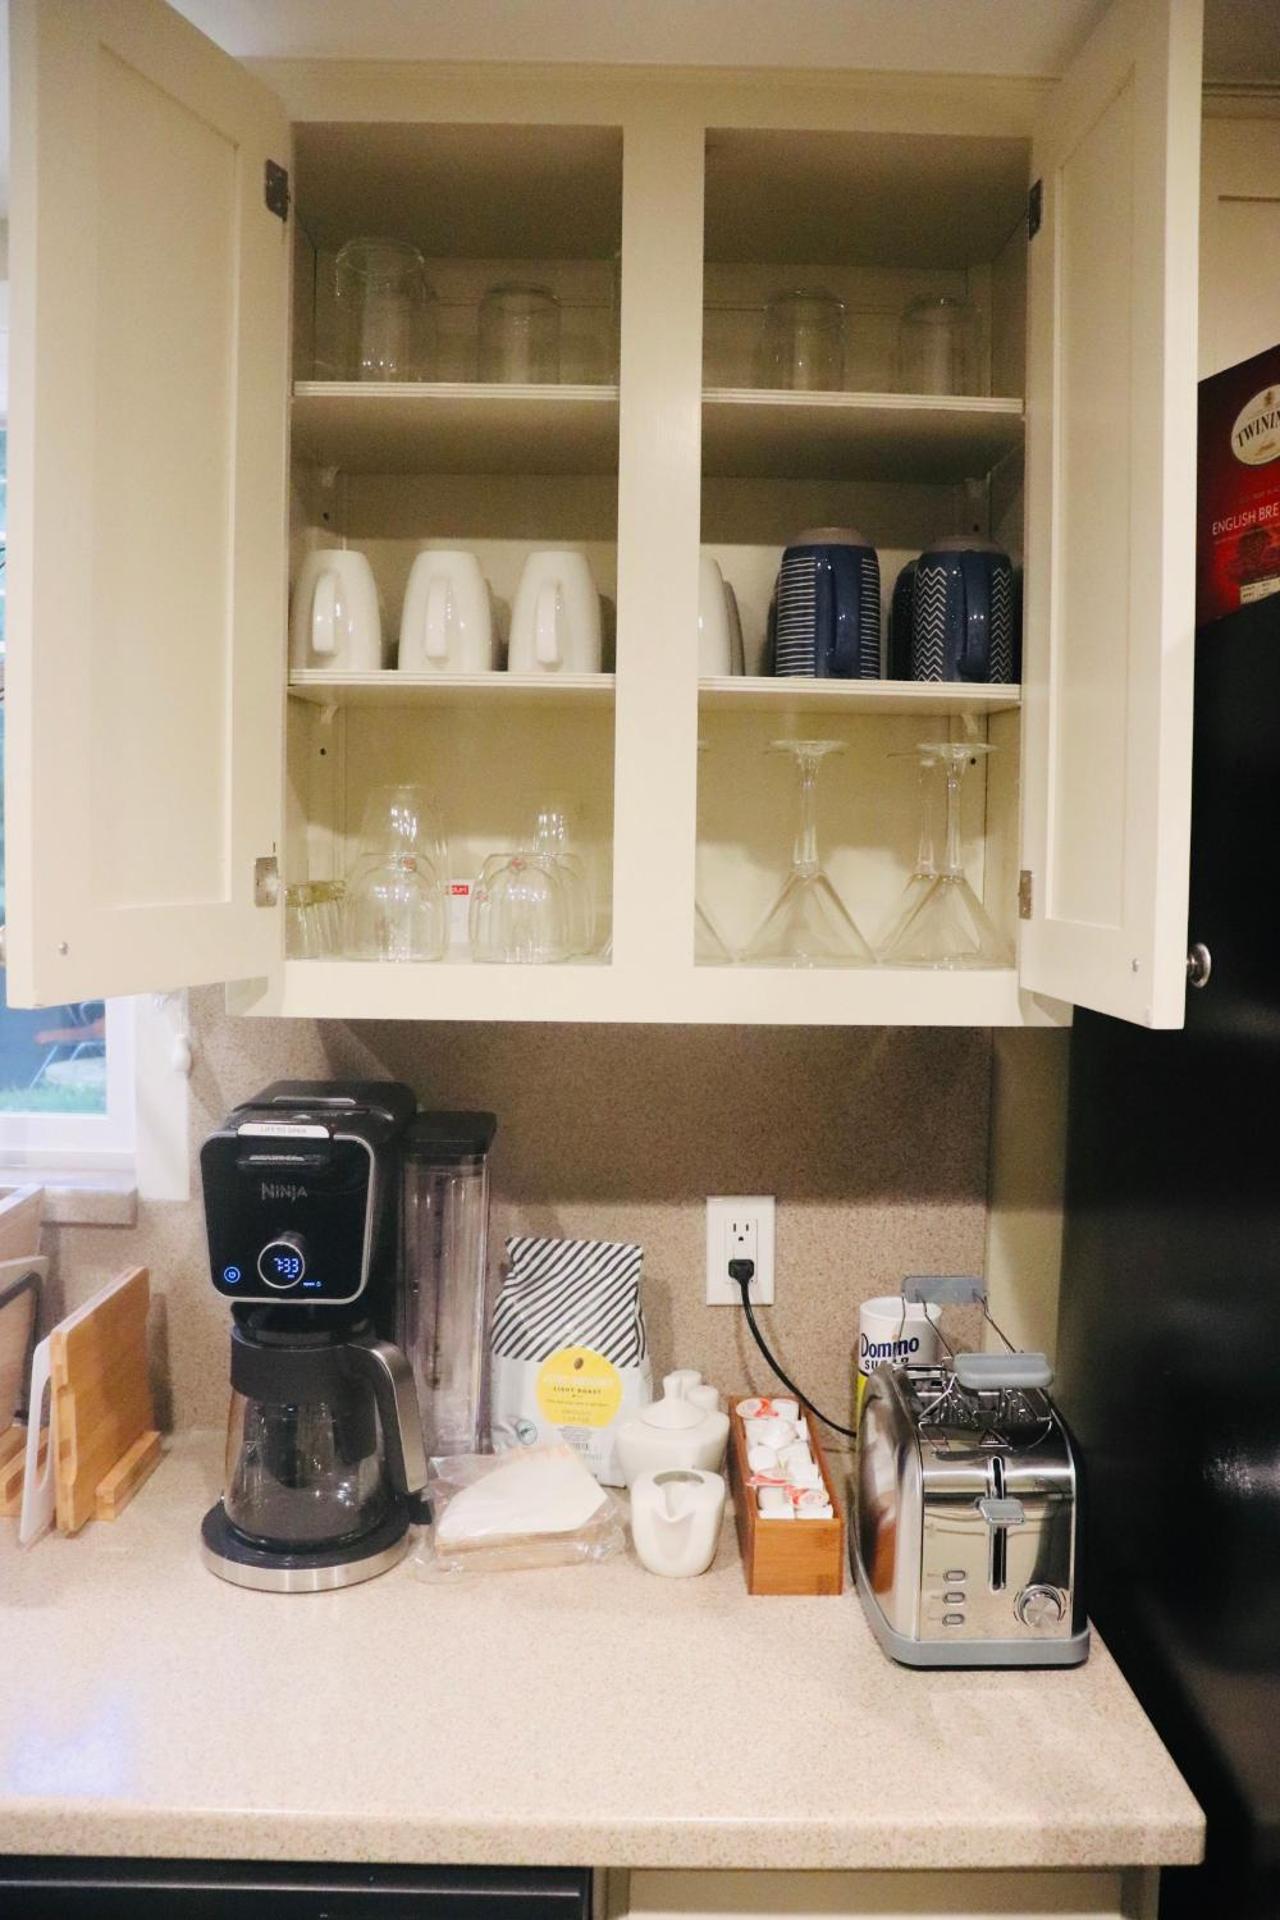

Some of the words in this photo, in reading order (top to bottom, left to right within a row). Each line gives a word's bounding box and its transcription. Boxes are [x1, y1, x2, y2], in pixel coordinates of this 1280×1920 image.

[1212, 510, 1257, 536] ENGLISH
[261, 1181, 308, 1202] NINJA
[273, 1257, 299, 1273] 7:33
[860, 1333, 920, 1358] Domino
[864, 1357, 910, 1370] SUR
